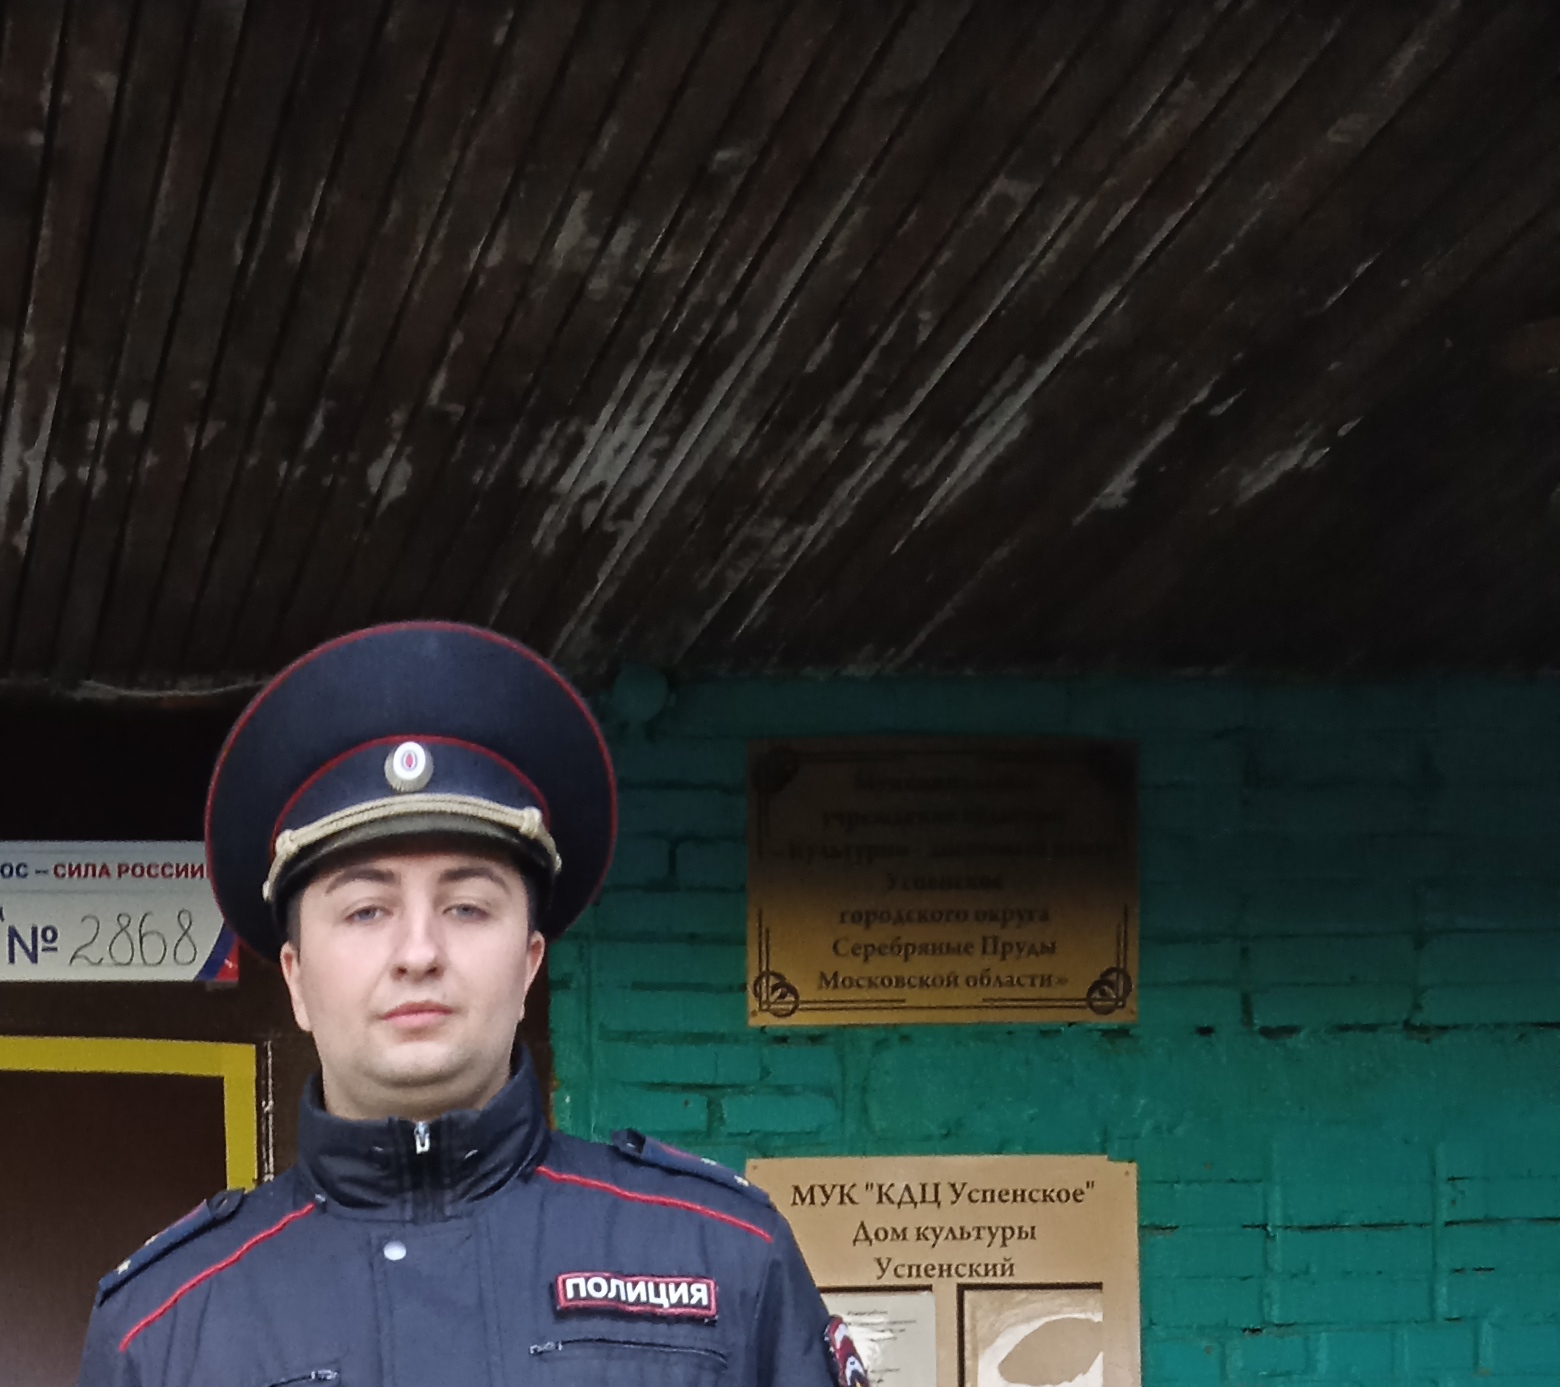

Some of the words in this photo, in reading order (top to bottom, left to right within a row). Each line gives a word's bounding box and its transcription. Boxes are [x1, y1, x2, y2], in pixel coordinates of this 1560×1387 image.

[53, 862, 111, 879] СИЛА
[840, 907, 968, 929] городского
[974, 907, 1049, 929] округа
[7, 924, 59, 965] №
[69, 909, 197, 966] 2868
[833, 938, 974, 962] Серебряные
[982, 936, 1056, 961] Пруды
[818, 969, 958, 990] Московской
[791, 1184, 859, 1206] МУК
[865, 1182, 940, 1209] "КДЦ
[949, 1181, 1095, 1205] Успенское"
[853, 1222, 909, 1246] Дом
[916, 1224, 1036, 1247] культуры
[876, 1257, 1015, 1279] Успенский
[565, 1277, 708, 1307] ПОЛИЦИЯ
